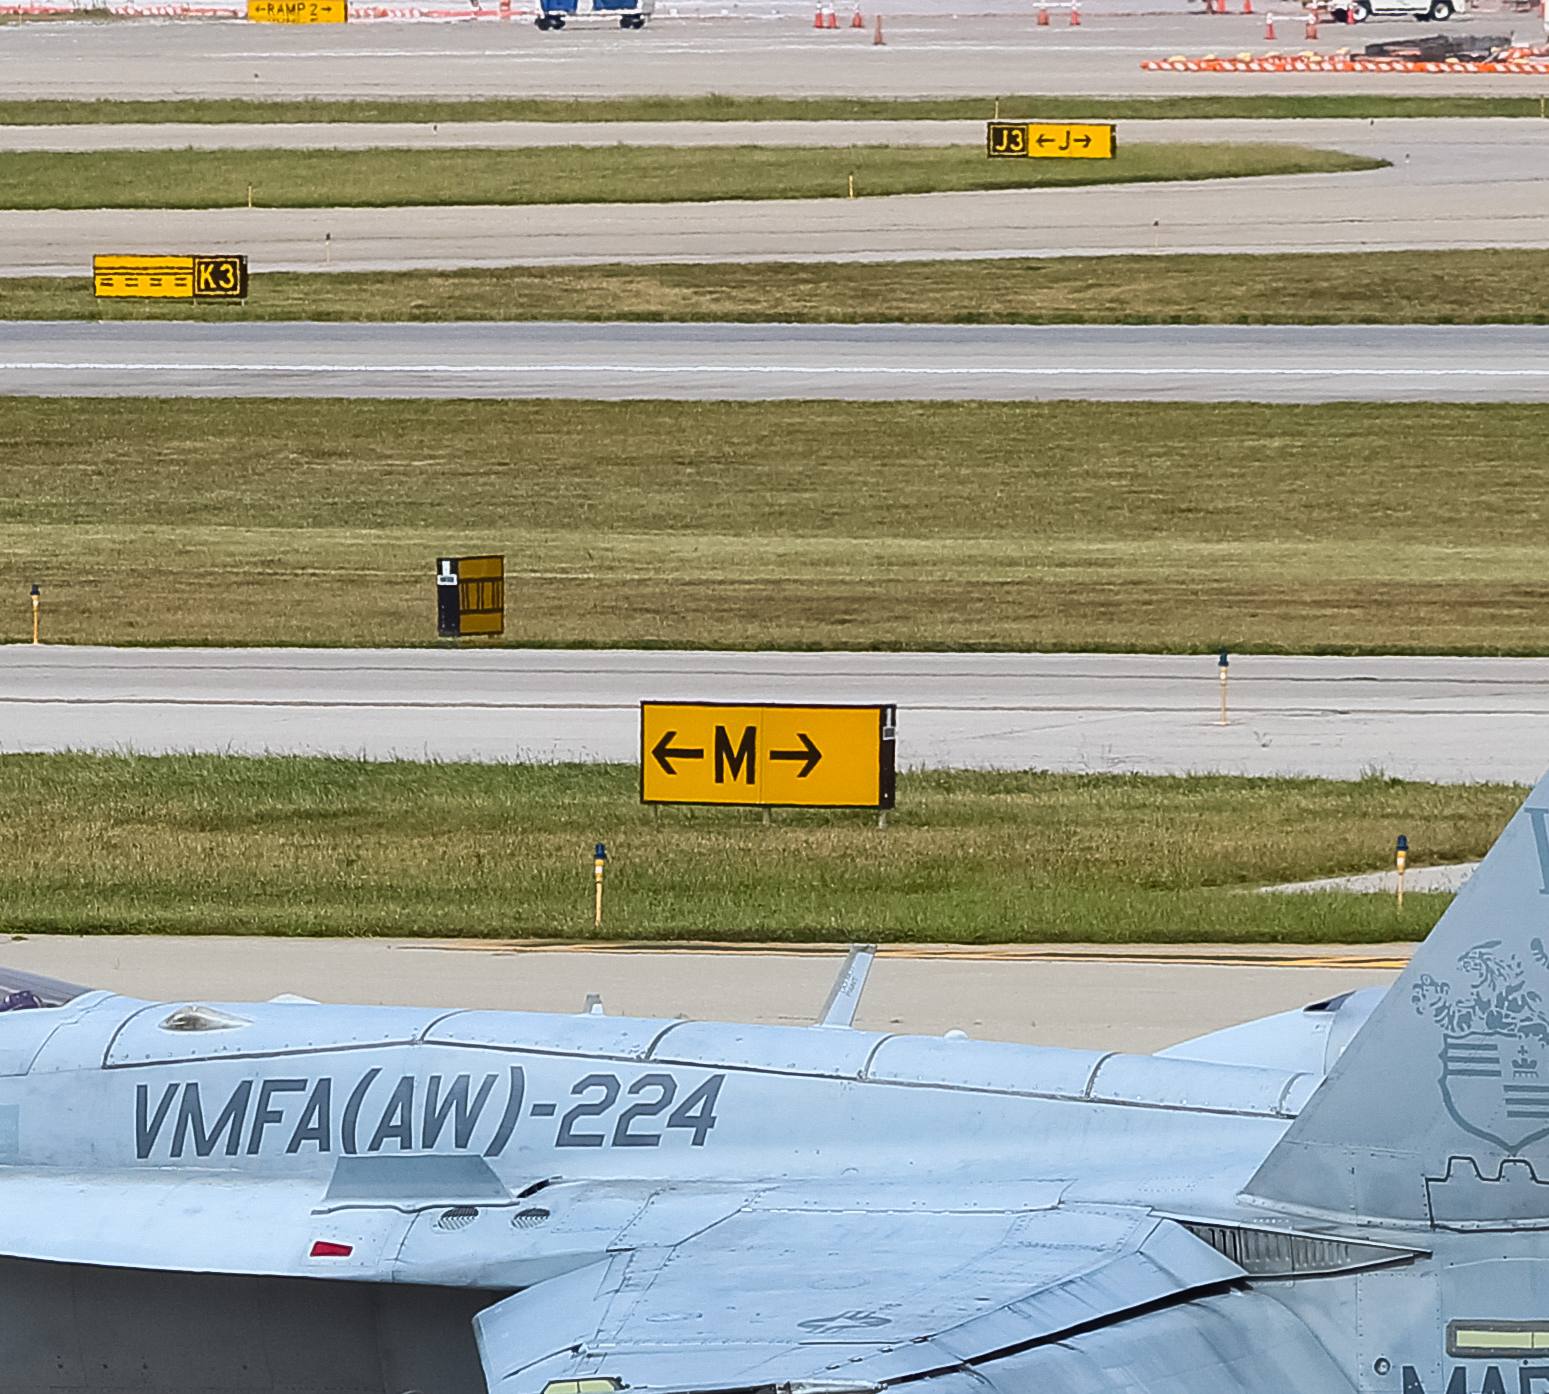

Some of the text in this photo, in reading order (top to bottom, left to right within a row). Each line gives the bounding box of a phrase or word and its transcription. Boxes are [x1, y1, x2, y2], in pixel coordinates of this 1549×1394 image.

[995, 129, 1024, 151] J3
[1058, 130, 1071, 151] J
[199, 263, 235, 290] K3
[714, 725, 758, 785] M
[134, 1064, 727, 1160] VMFA(AW)-224
